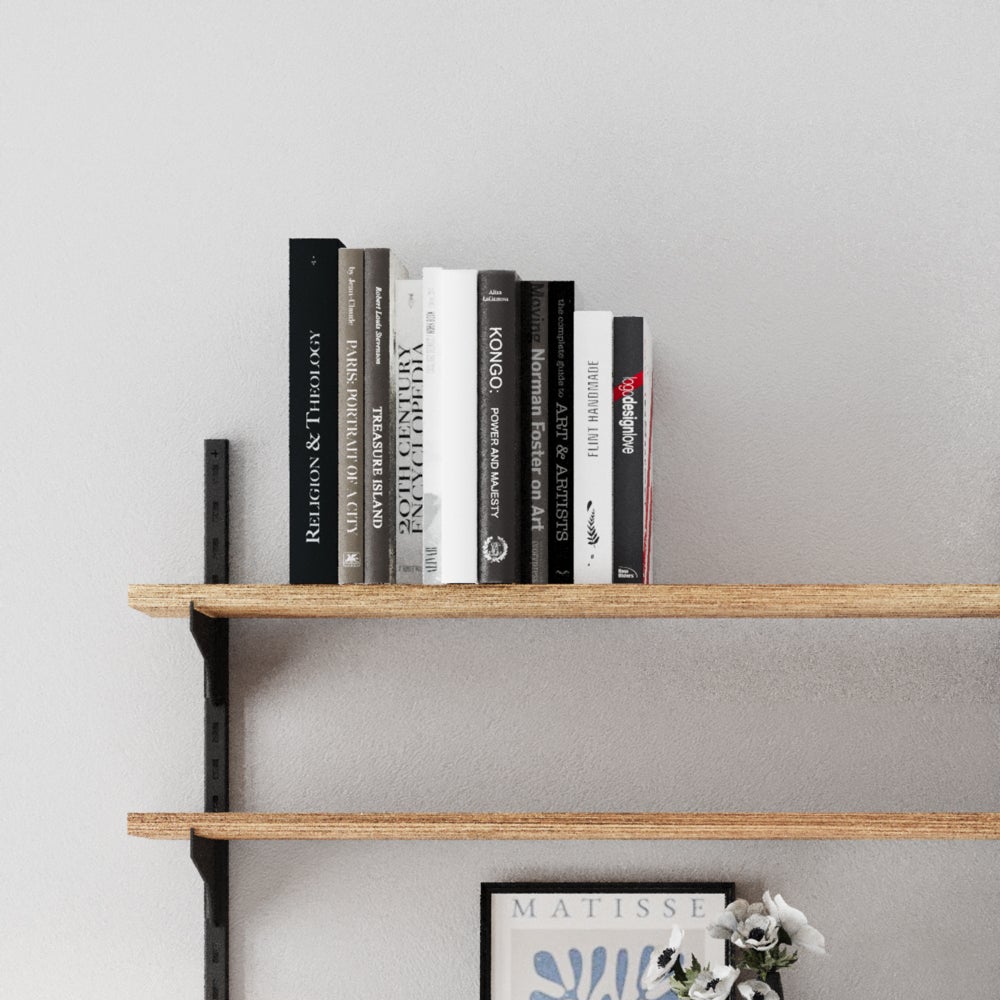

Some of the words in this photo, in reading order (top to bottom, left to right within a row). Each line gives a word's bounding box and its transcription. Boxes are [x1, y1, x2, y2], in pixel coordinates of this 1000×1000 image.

[375, 286, 383, 310] Robert
[528, 283, 545, 343] Moving
[557, 299, 566, 314] the
[375, 311, 383, 330] Louis
[556, 316, 567, 358] complete
[345, 340, 358, 384] PARIS:
[375, 331, 383, 365] Stevenson
[488, 327, 503, 393] KONGO:
[399, 343, 411, 458] CENTURY
[530, 348, 545, 416] Norman
[588, 359, 599, 422] HANDMADE
[345, 389, 358, 462] PORTRAIT
[490, 407, 500, 447] POWER
[556, 402, 568, 440] ART
[619, 376, 638, 454] logodesignlove
[305, 432, 321, 451] &
[372, 406, 383, 475] TREASURE
[490, 448, 500, 469] AND
[530, 421, 545, 473] Foster
[556, 444, 568, 461] &
[588, 427, 599, 457] FLINT
[345, 467, 358, 484] OF
[345, 490, 358, 498] A
[490, 471, 500, 519] MAJESTY
[530, 479, 541, 500] on
[345, 502, 358, 536] CITY
[372, 479, 383, 529] ISLAND
[530, 505, 545, 531] Art
[556, 464, 568, 542] ARTISTS
[512, 898, 706, 918] MATISSE
